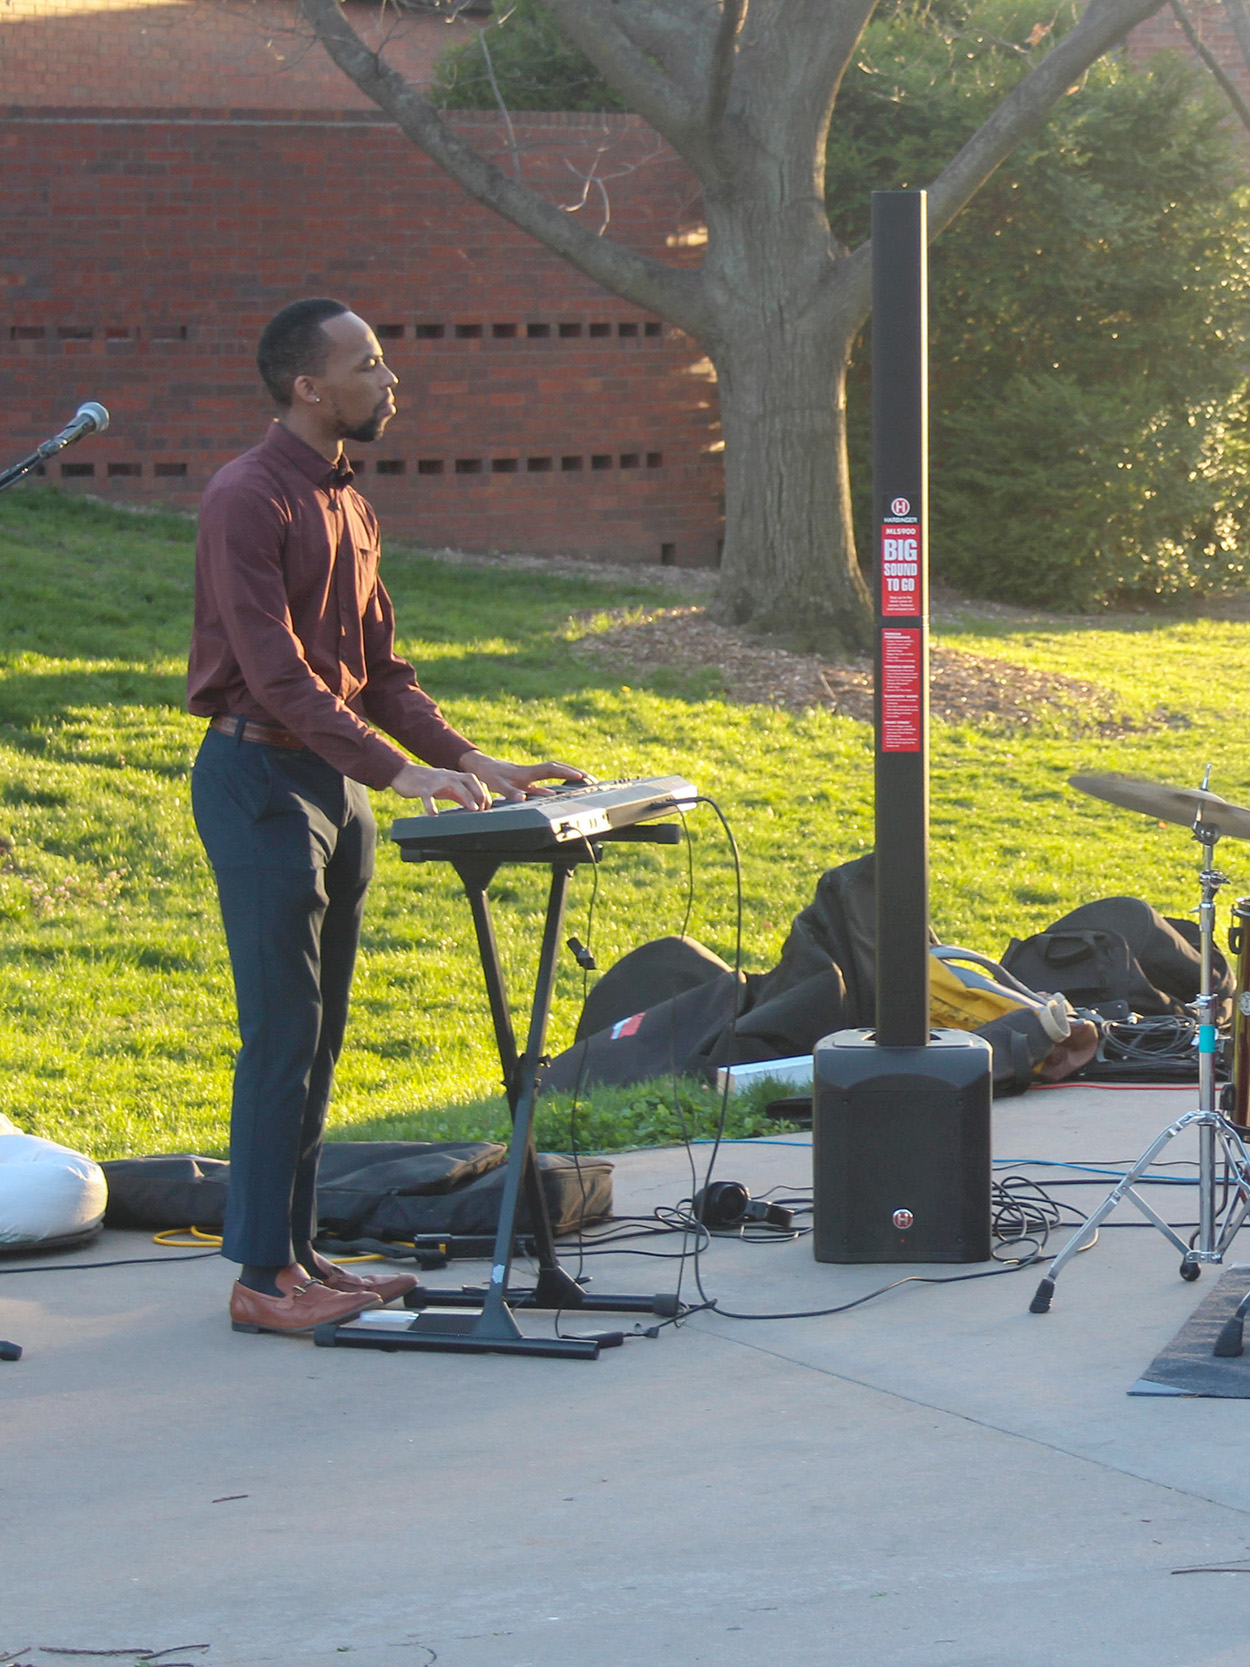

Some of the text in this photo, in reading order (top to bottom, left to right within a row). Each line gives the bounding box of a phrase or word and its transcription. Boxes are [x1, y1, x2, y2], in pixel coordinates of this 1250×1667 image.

[884, 539, 918, 561] BIG
[884, 563, 918, 576] SOUND
[887, 578, 915, 592] TO GO
